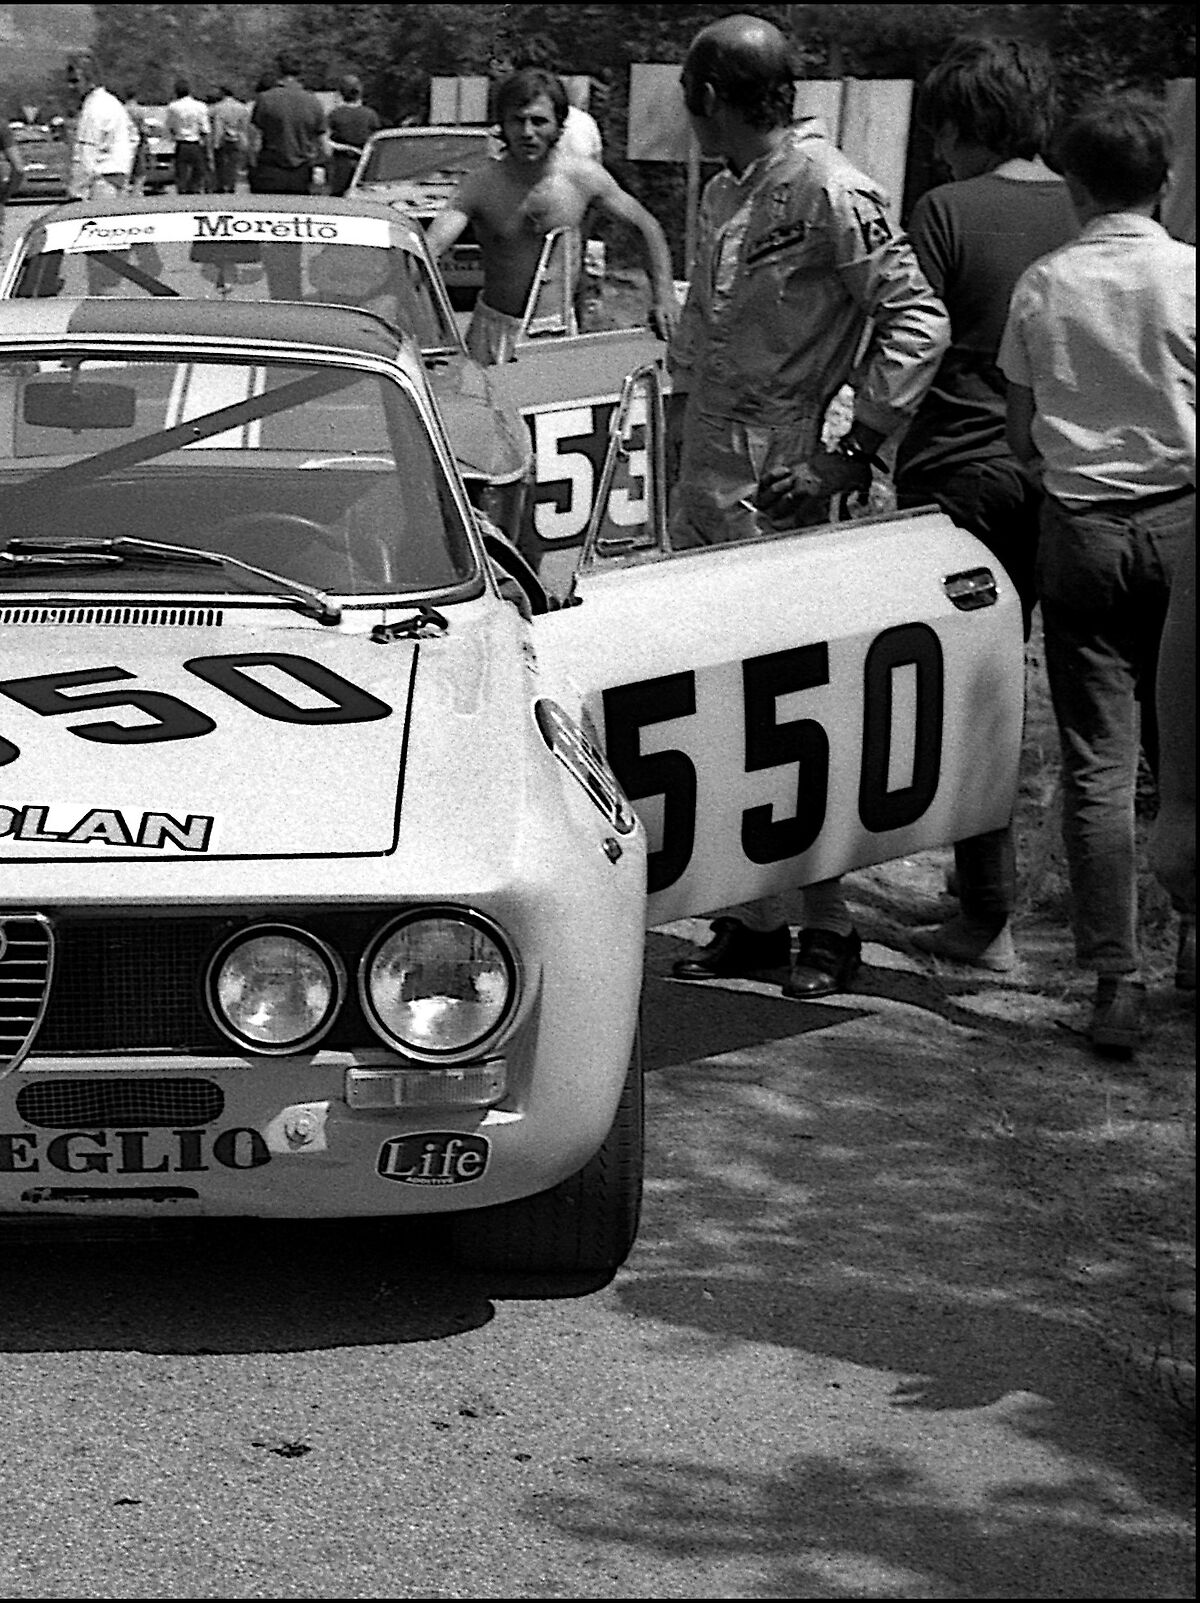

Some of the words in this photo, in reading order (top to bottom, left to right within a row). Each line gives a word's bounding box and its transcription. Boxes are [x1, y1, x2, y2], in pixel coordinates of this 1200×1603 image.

[194, 214, 339, 240] Moretto
[601, 621, 944, 896] 550
[382, 1139, 483, 1177] Life
